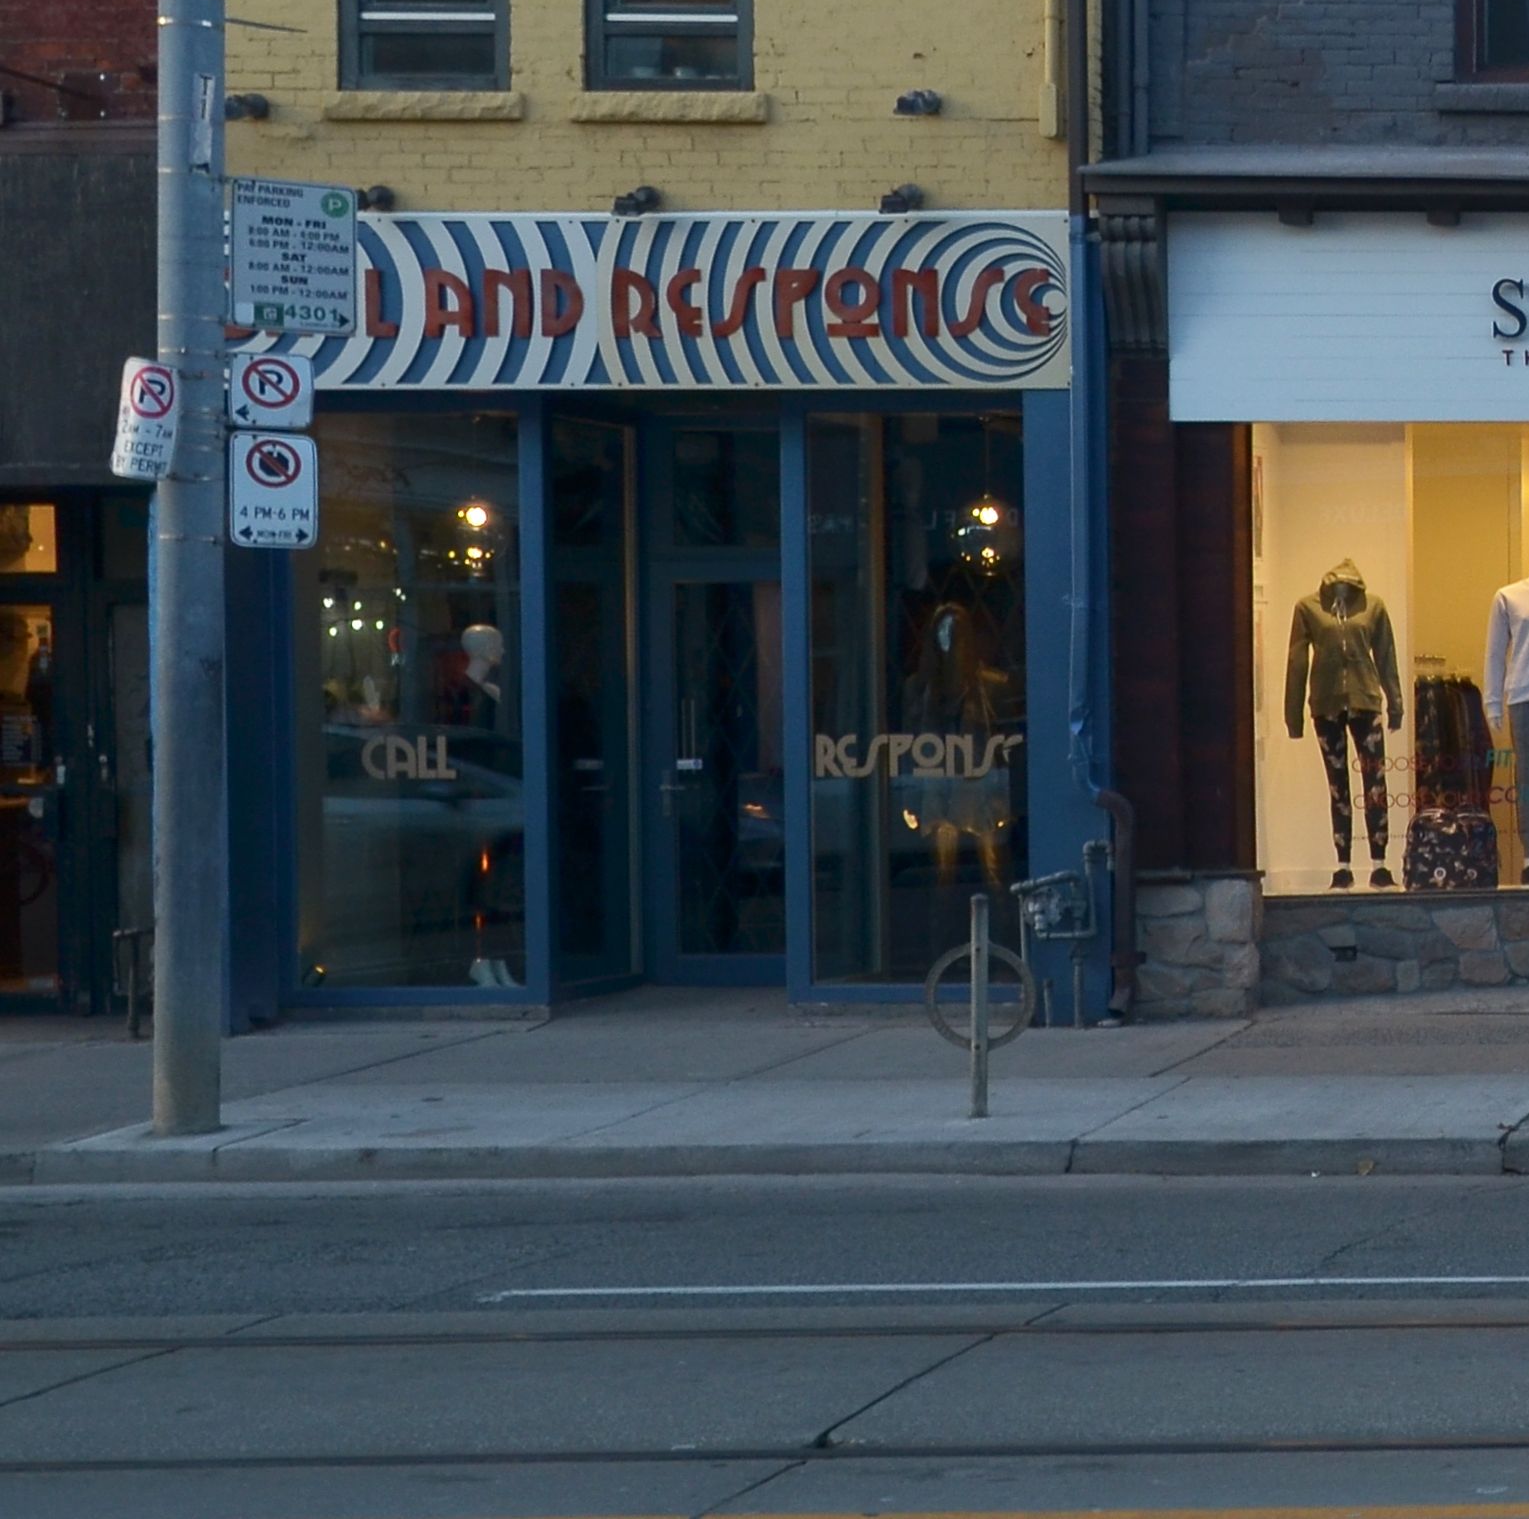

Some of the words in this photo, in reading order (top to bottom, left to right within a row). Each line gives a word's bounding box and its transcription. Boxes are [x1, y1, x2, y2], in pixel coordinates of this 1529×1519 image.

[237, 183, 256, 193] PAY
[258, 185, 304, 198] PARKING
[237, 194, 291, 208] ENFORCED
[261, 215, 294, 227] MON
[305, 219, 327, 230] FRI
[272, 227, 290, 238] AM
[323, 232, 340, 242] PM
[273, 240, 290, 250] PM
[281, 253, 307, 263] SAT
[272, 263, 290, 273] AM
[281, 275, 308, 285] SUN
[272, 285, 289, 296] PM
[425, 268, 584, 338] AND
[611, 266, 1050, 338] RESPONSE
[284, 304, 338, 322] 4301
[124, 440, 164, 456] EXCEPT
[116, 454, 126, 468] BY
[240, 505, 249, 518] 4
[292, 508, 310, 522] PM
[361, 735, 457, 779] CALL
[1485, 749, 1514, 768] FIT
